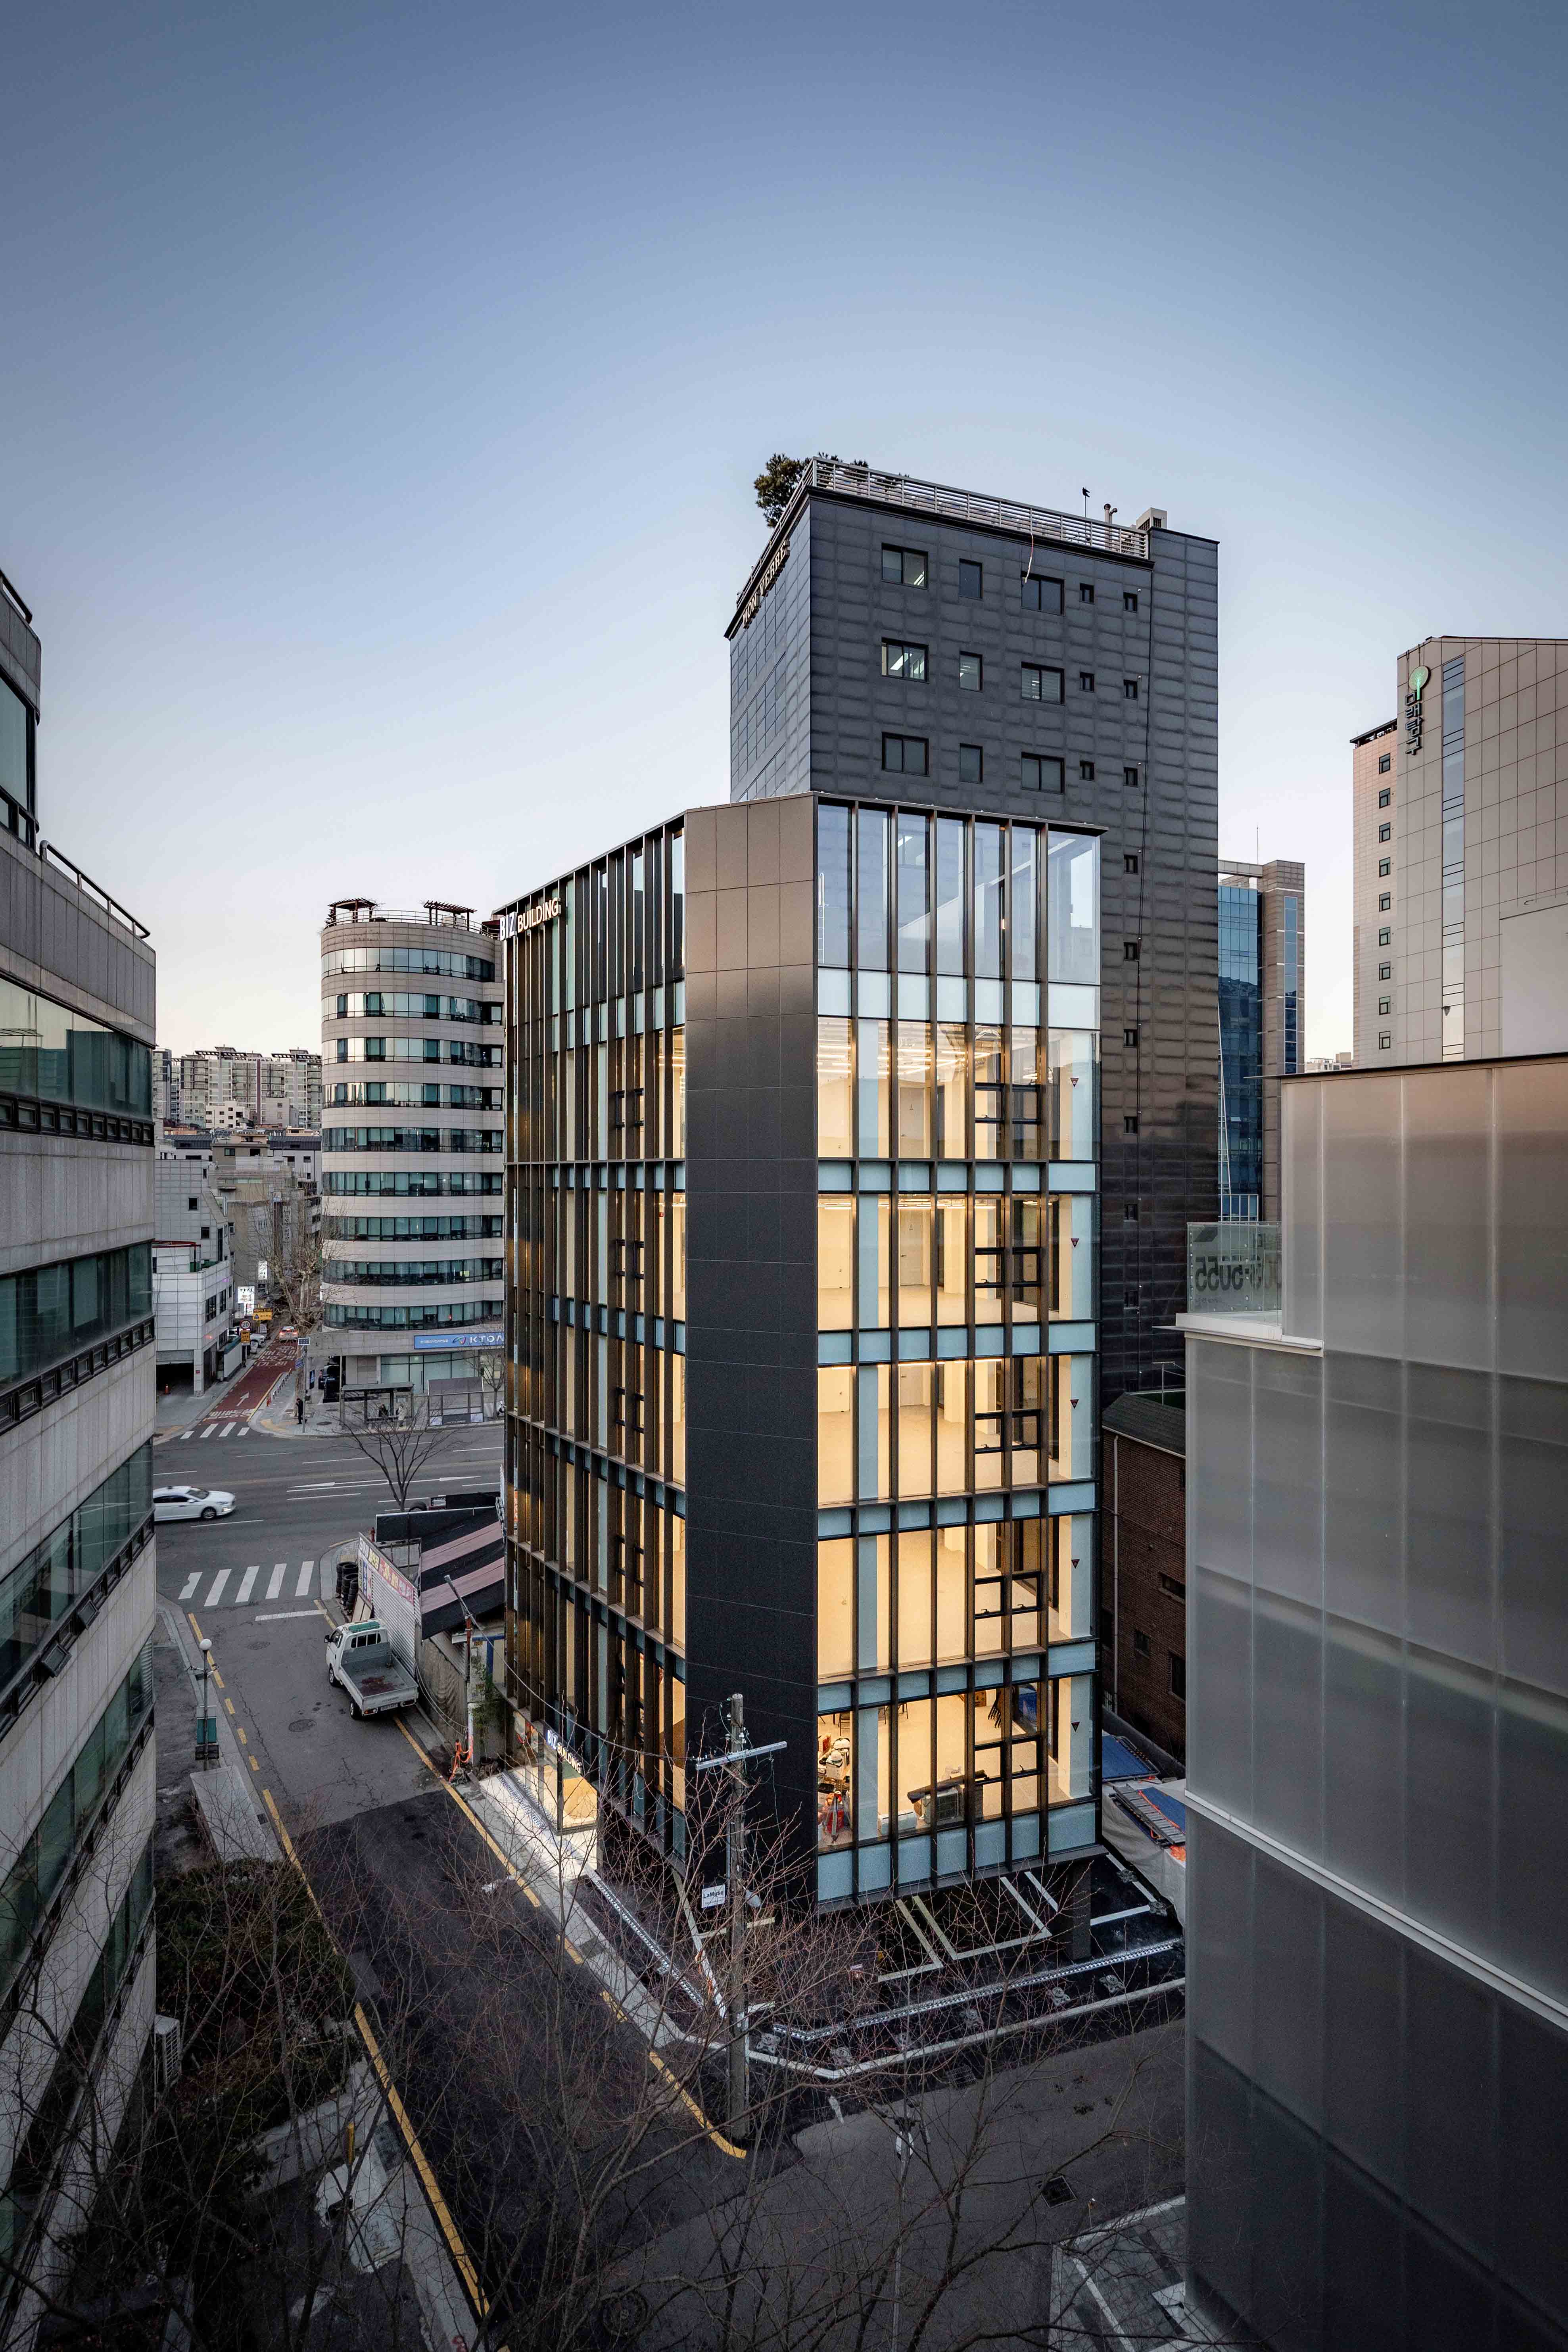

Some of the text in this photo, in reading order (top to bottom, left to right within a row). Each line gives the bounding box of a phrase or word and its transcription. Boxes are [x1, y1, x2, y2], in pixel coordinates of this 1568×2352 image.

[759, 540, 788, 596] VERRE
[1405, 689, 1422, 755] 미래탐구
[500, 897, 559, 941] BIZ BUILDING
[547, 1730, 581, 1774] BIZ BUILDING
[703, 1890, 724, 1899] LaMuse
